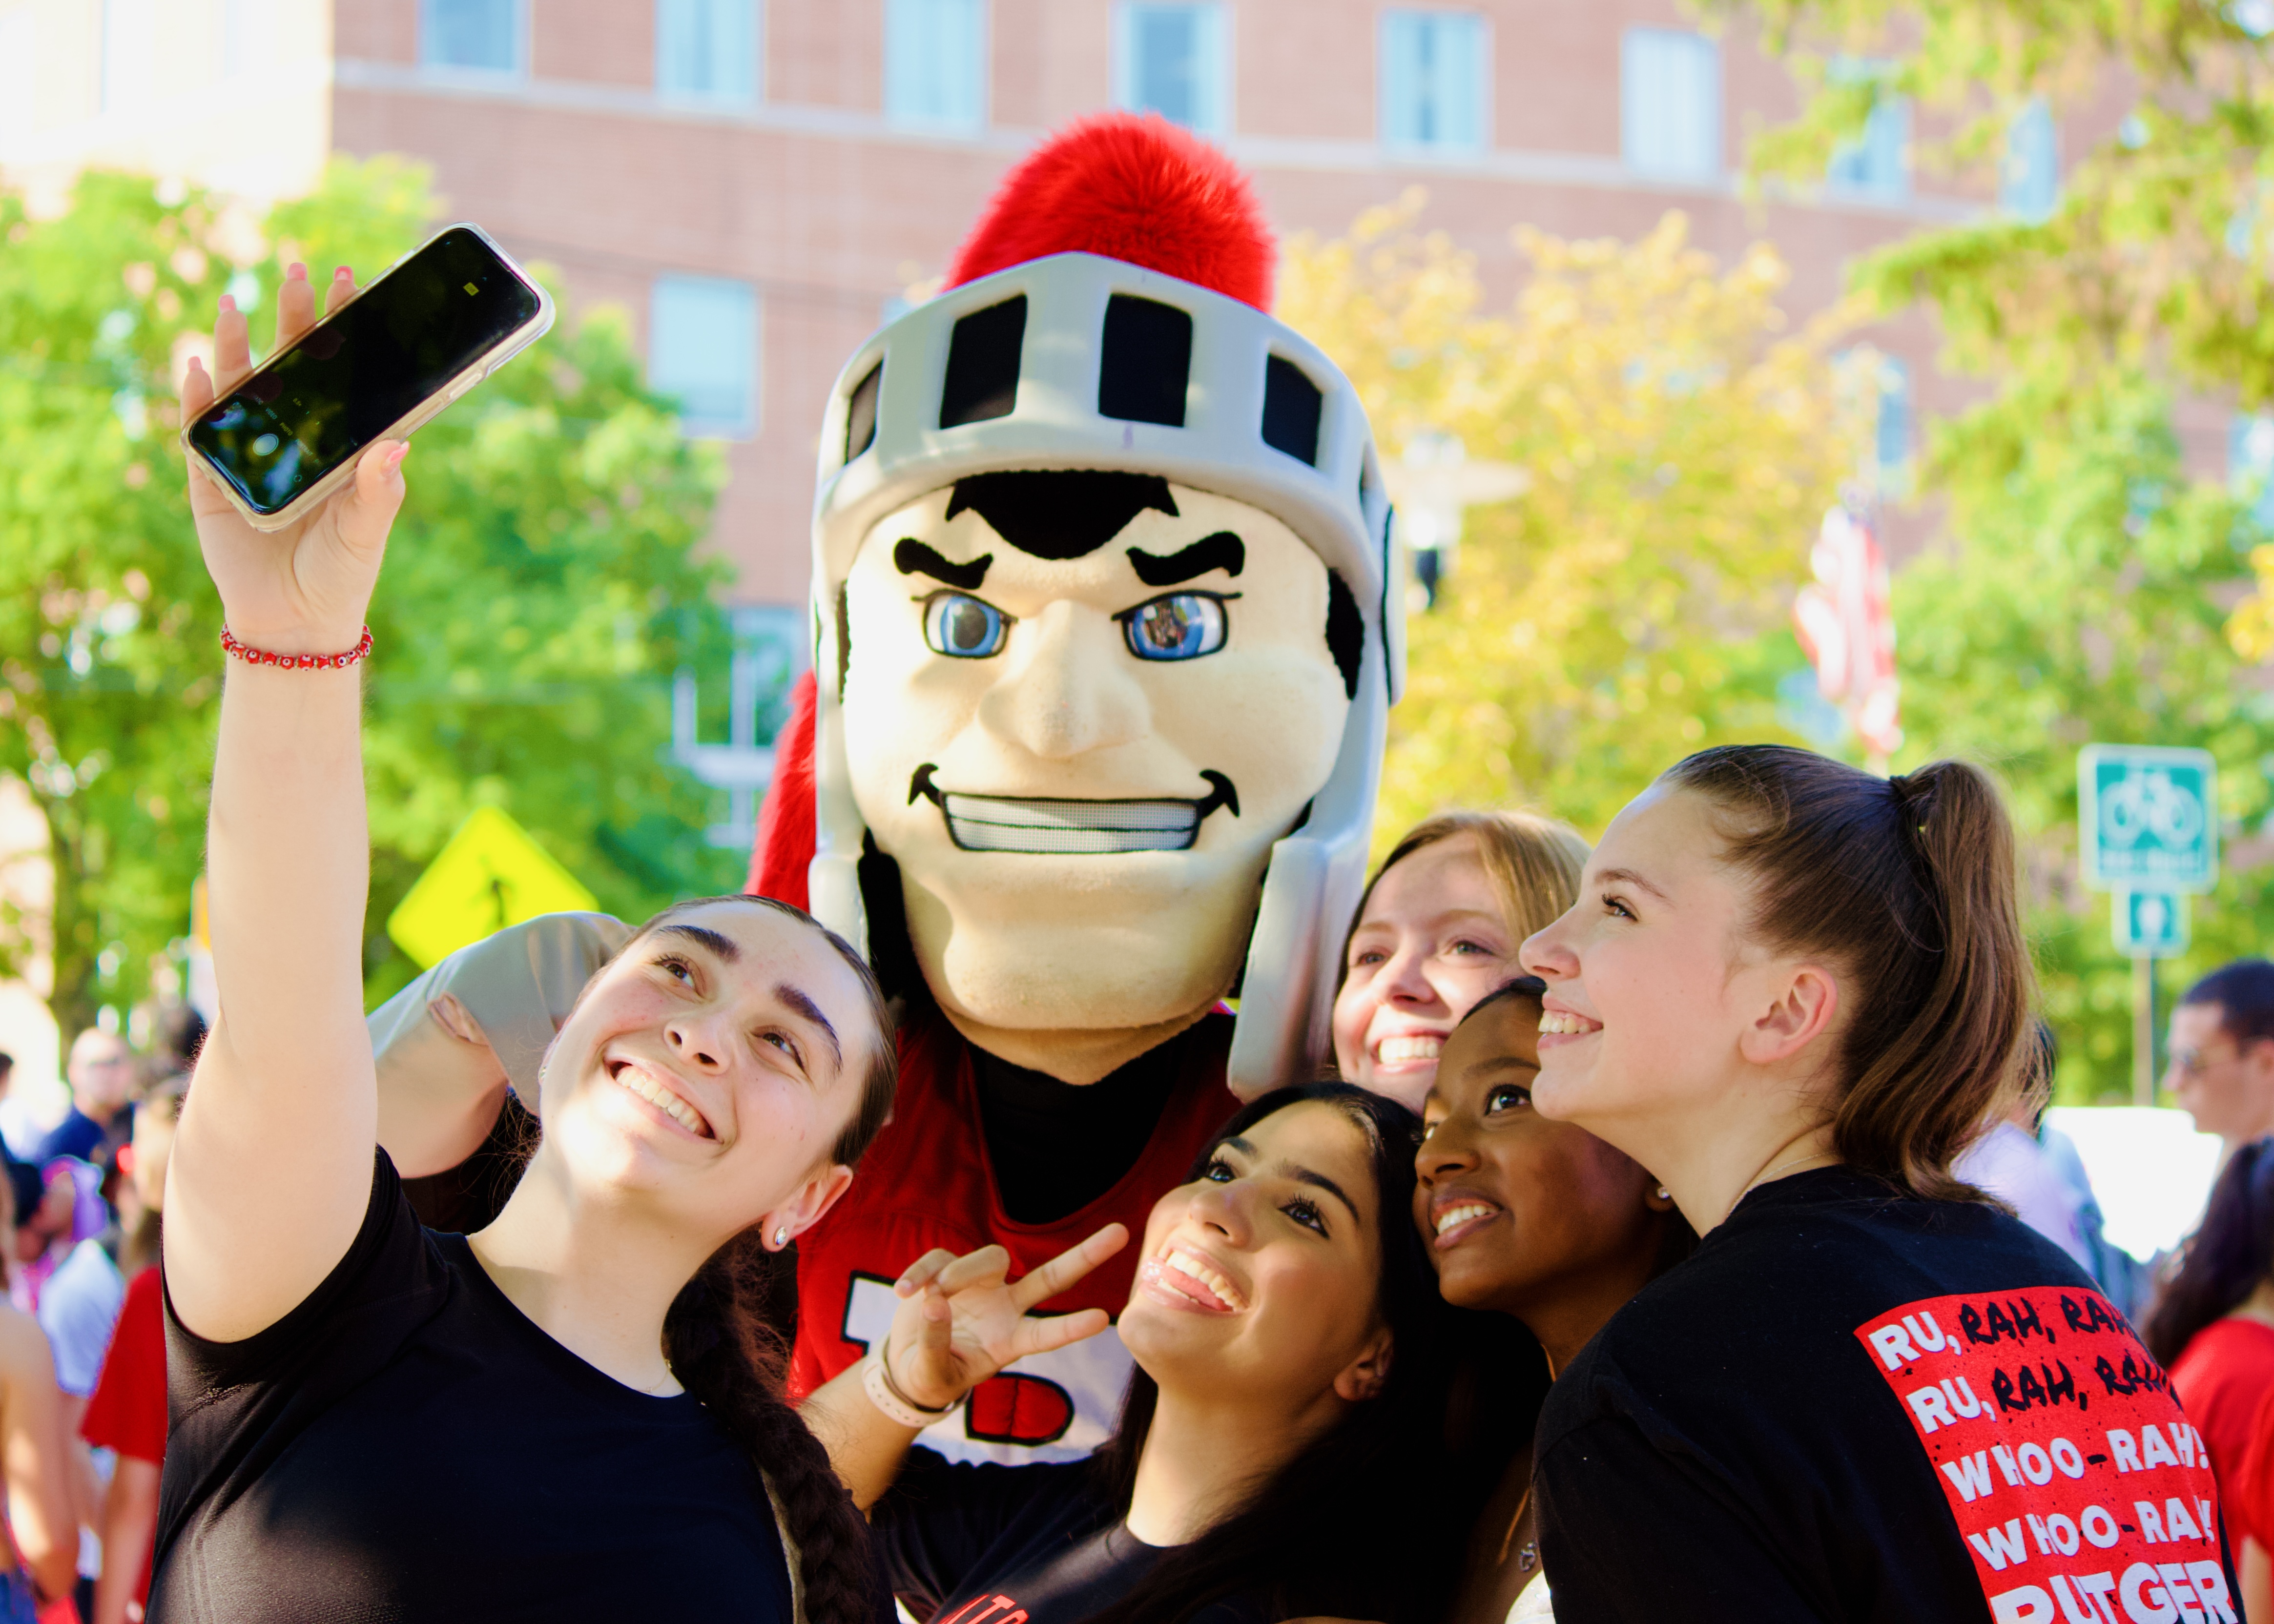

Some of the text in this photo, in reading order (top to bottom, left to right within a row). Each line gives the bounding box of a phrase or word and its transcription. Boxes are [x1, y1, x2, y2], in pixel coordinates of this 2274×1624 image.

[266, 408, 277, 419] VIDEO
[279, 422, 293, 436] PHOTO
[1868, 1311, 1962, 1372] RU,
[1959, 1297, 2056, 1345] RAH,
[1905, 1376, 1997, 1434] RU,
[1991, 1358, 2088, 1412] RAH,
[1940, 1422, 2209, 1502] WHOO-RAH!
